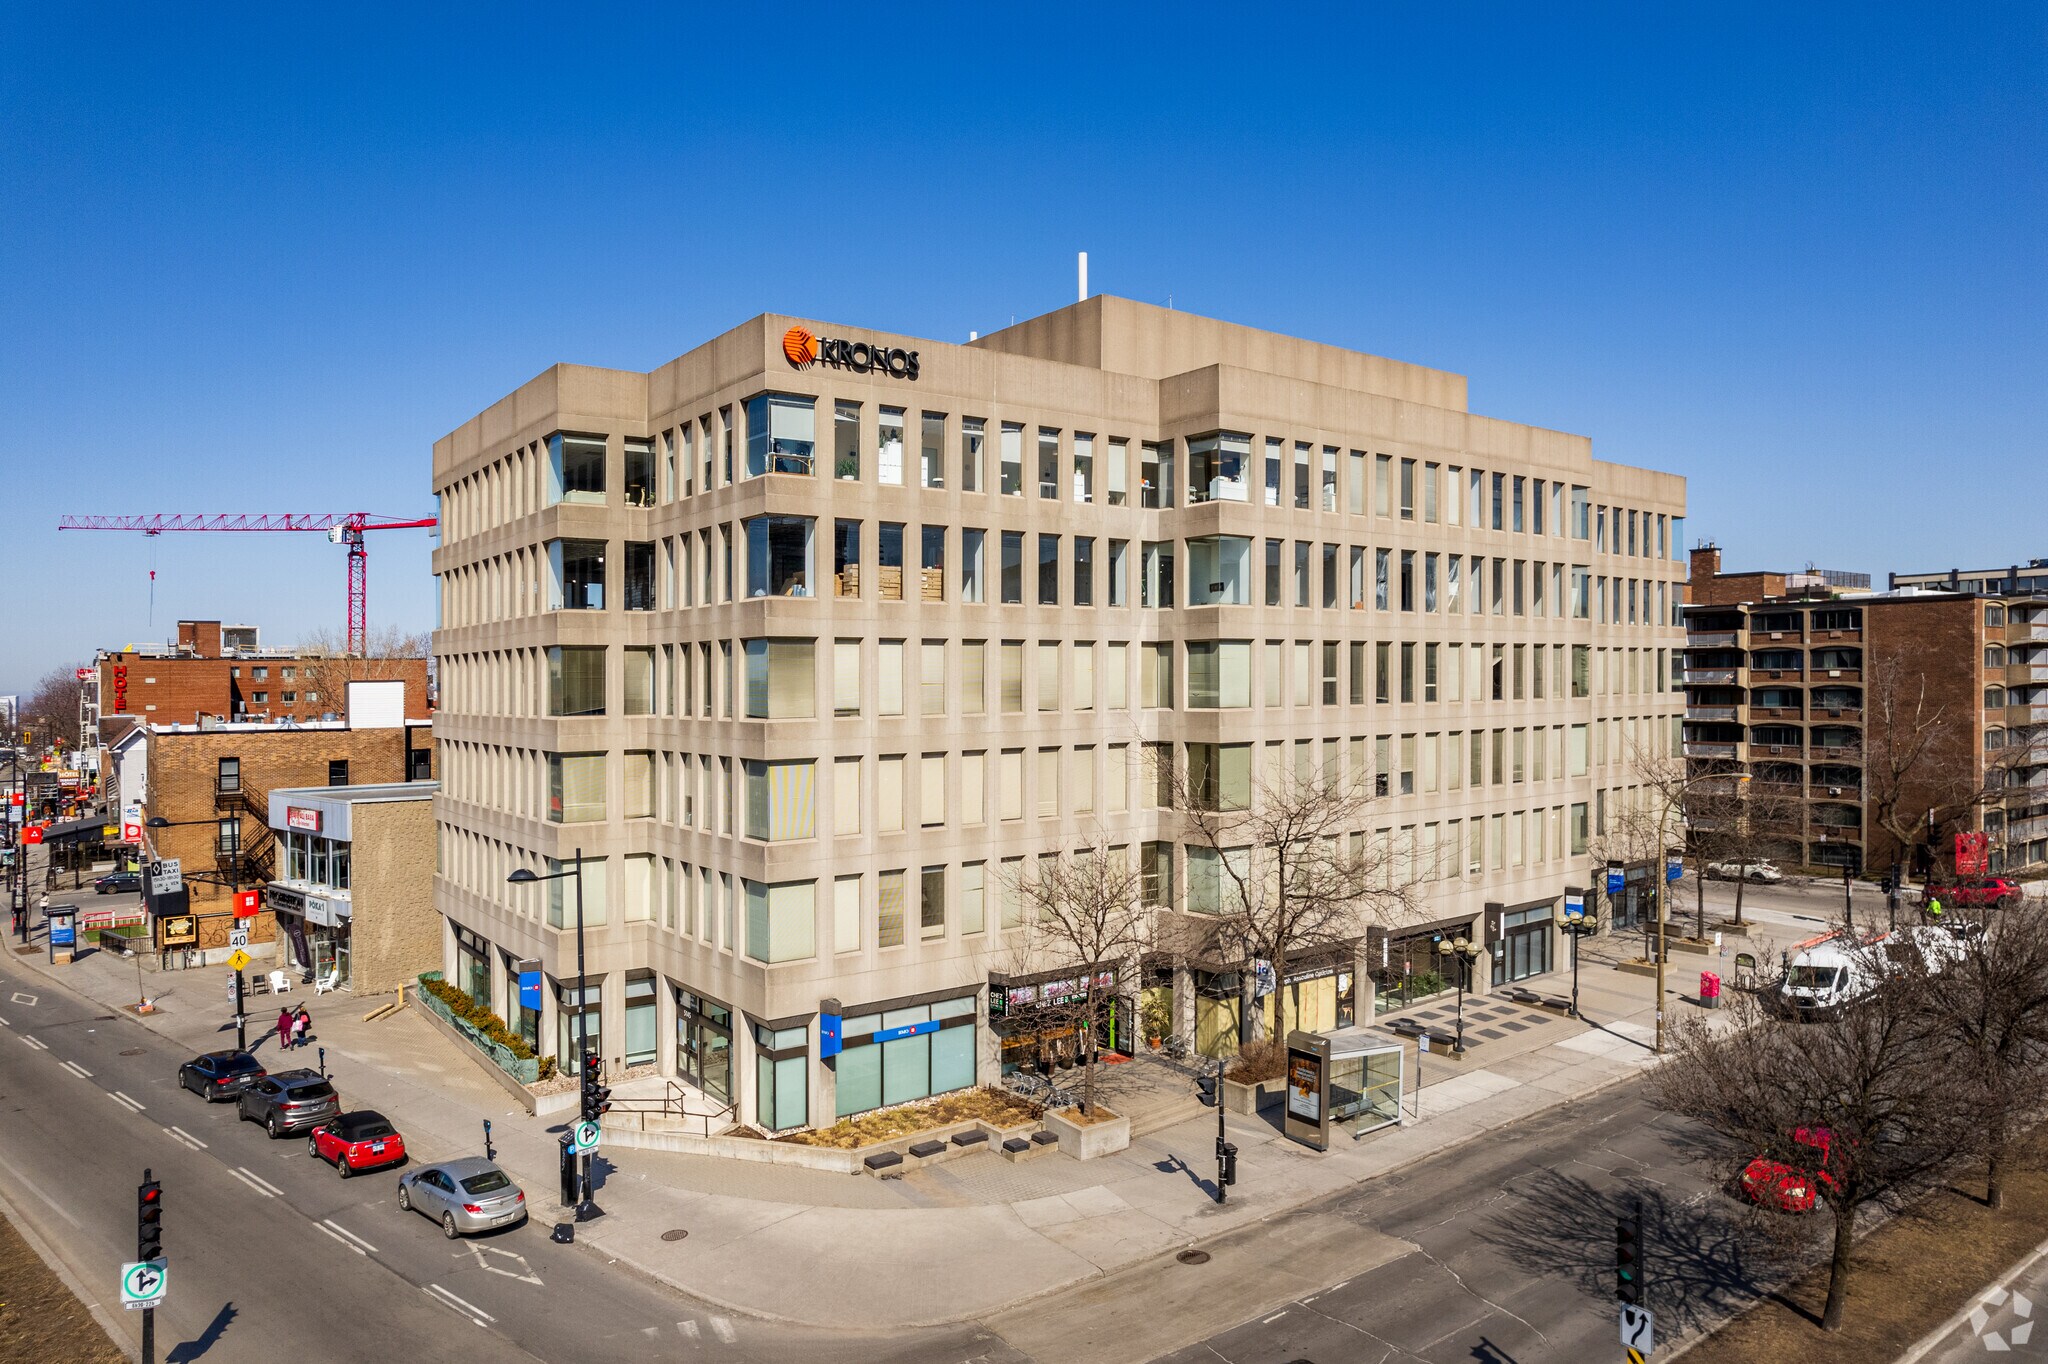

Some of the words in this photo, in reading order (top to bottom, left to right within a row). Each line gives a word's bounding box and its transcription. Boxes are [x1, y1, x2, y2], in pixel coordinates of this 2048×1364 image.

[821, 336, 920, 374] KRONOS
[231, 934, 247, 947] 40
[1052, 996, 1065, 1006] LEE
[898, 1028, 910, 1036] BMO
